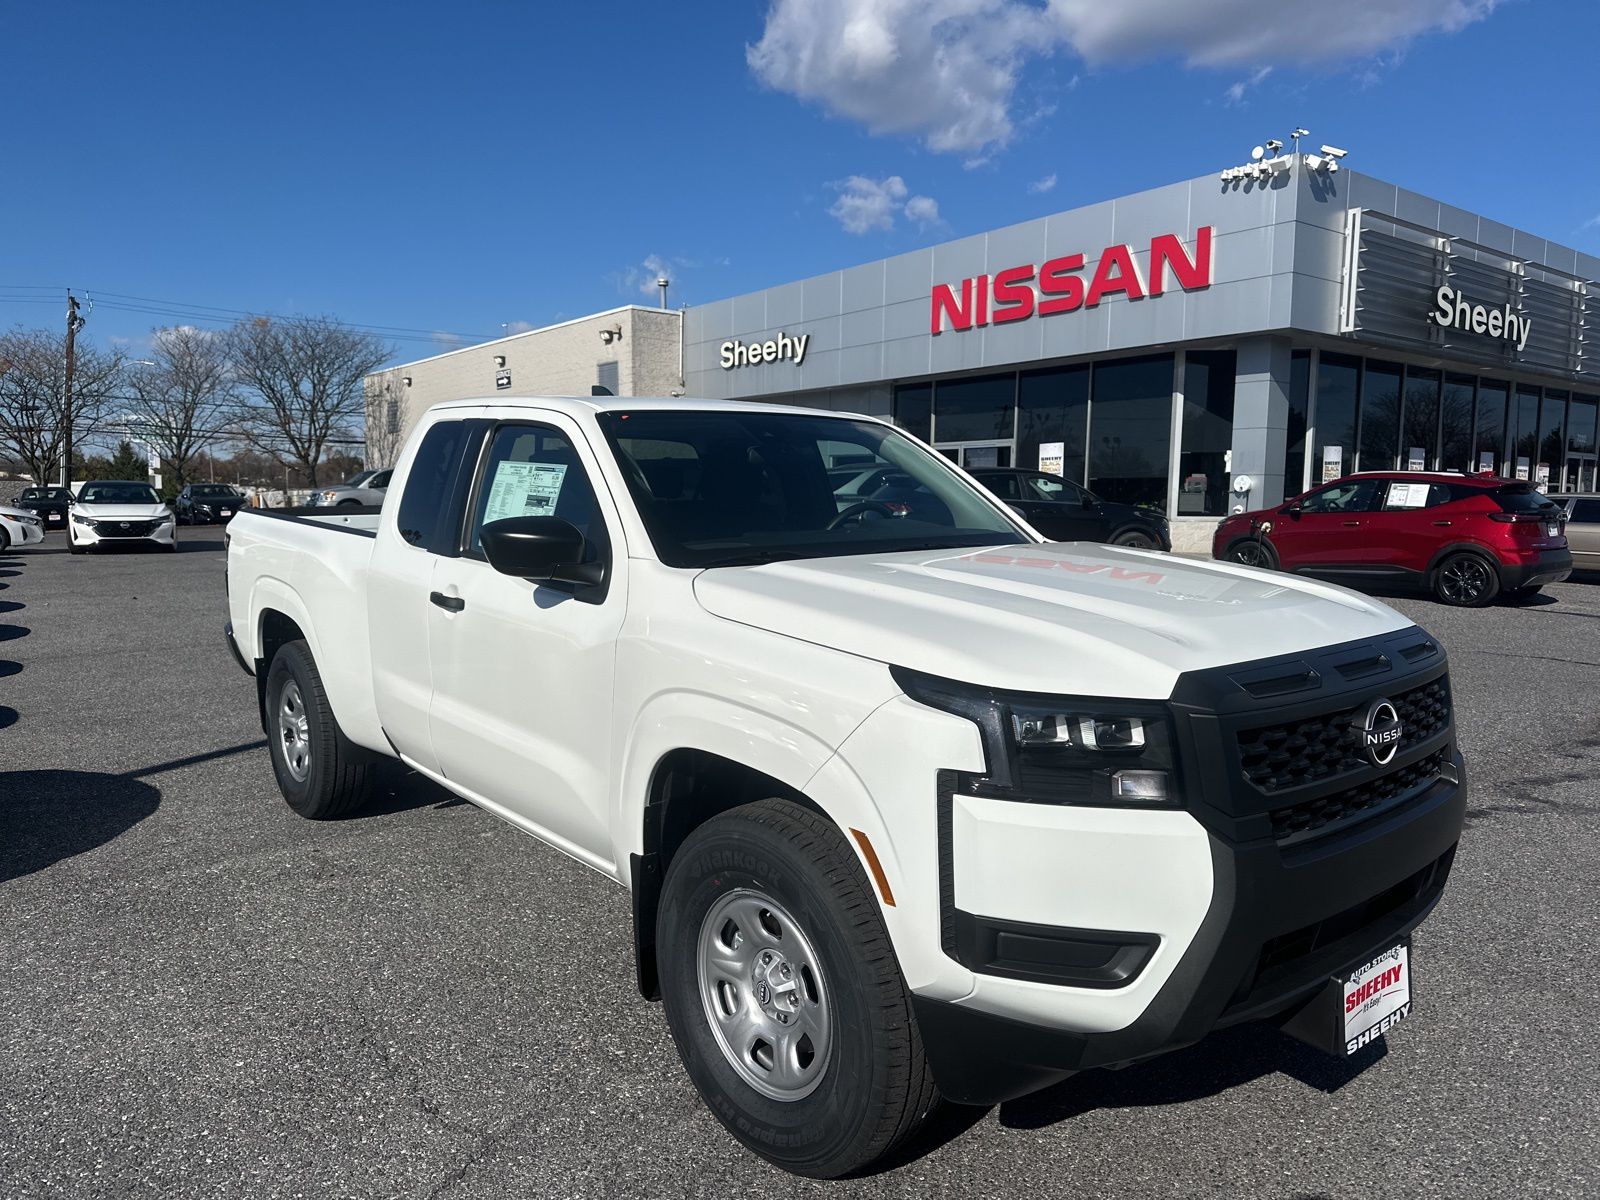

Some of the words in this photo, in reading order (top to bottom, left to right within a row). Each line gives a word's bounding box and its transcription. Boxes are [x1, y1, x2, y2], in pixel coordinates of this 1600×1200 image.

[931, 226, 1214, 335] NISSAN
[1435, 286, 1531, 351] Sheehy
[720, 332, 809, 369] Sheehy
[1345, 963, 1403, 1014] SHEEHY
[1350, 962, 1371, 983] AUTO
[1372, 944, 1402, 967] STORES
[1346, 1002, 1411, 1055] SHEEHY
